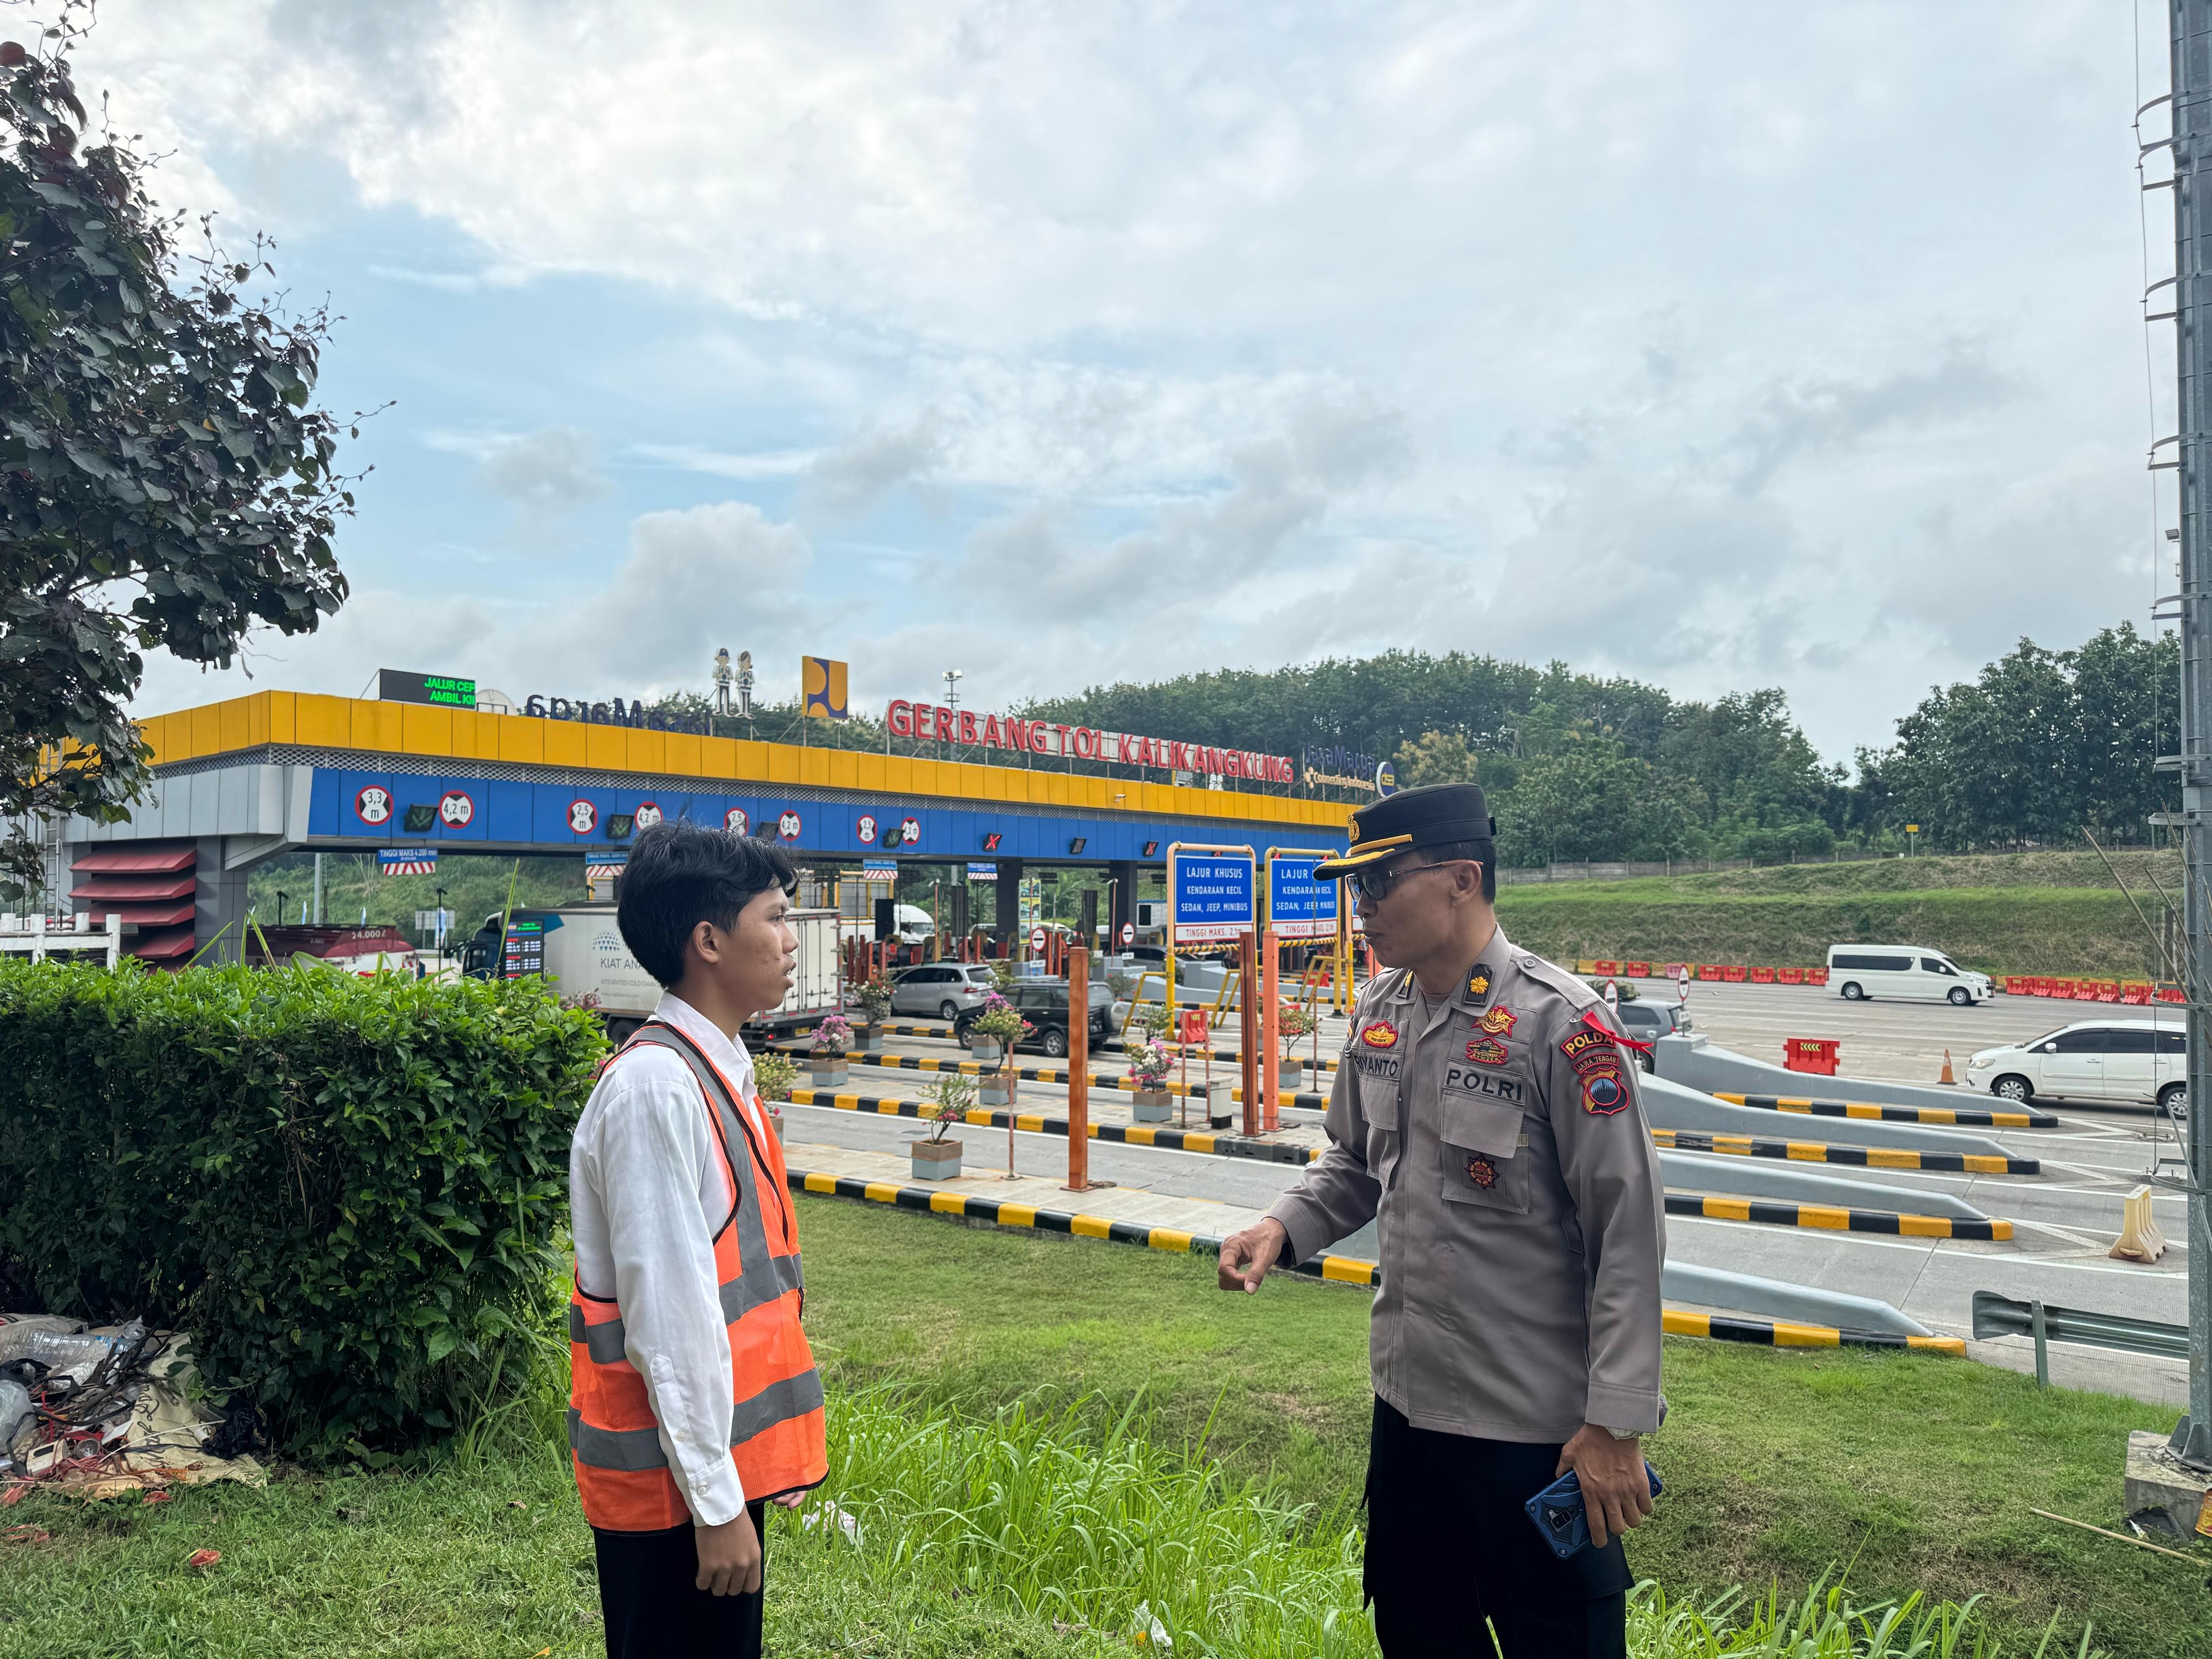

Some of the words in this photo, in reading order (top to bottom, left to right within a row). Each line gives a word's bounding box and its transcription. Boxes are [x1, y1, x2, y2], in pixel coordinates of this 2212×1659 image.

[424, 677, 456, 691] JALUR
[430, 691, 461, 704] AMBIL
[887, 699, 1047, 754] GERBANG
[1055, 724, 1109, 762] TOL
[1119, 733, 1294, 783] KALIKANGKUNG
[368, 792, 382, 805] 3,3
[371, 809, 379, 819] m
[444, 804, 457, 816] 4,2
[461, 805, 468, 814] m
[577, 805, 589, 817] 2,5
[639, 813, 649, 824] 4,2
[579, 821, 586, 829] m
[863, 820, 872, 830] 2,5
[380, 849, 398, 858] TINGGI
[399, 849, 414, 857] MAKS
[1187, 867, 1211, 878] LAJUR
[1214, 868, 1243, 878] KHUSUS
[1281, 869, 1308, 879] LAJUR
[1187, 885, 1224, 895] KENDARAAN
[1226, 886, 1242, 895] KECIL
[1181, 903, 1203, 913] SEDAN,
[1206, 903, 1221, 912] JEEP,
[1223, 903, 1248, 911] MINIBUS
[1276, 902, 1300, 911] SEDAN,
[1320, 901, 1335, 909] MINIBUS
[352, 929, 381, 940] 24.000
[1186, 929, 1206, 937] TINGGI
[1209, 928, 1227, 937] MAKS.
[1285, 925, 1308, 933] TINGGI
[601, 957, 622, 969] KIAT
[1565, 1032, 1613, 1055] POLDA
[1578, 1058, 1594, 1071] JAWA
[1595, 1055, 1616, 1063] TENGAH
[1445, 1069, 1522, 1102] POLRI
